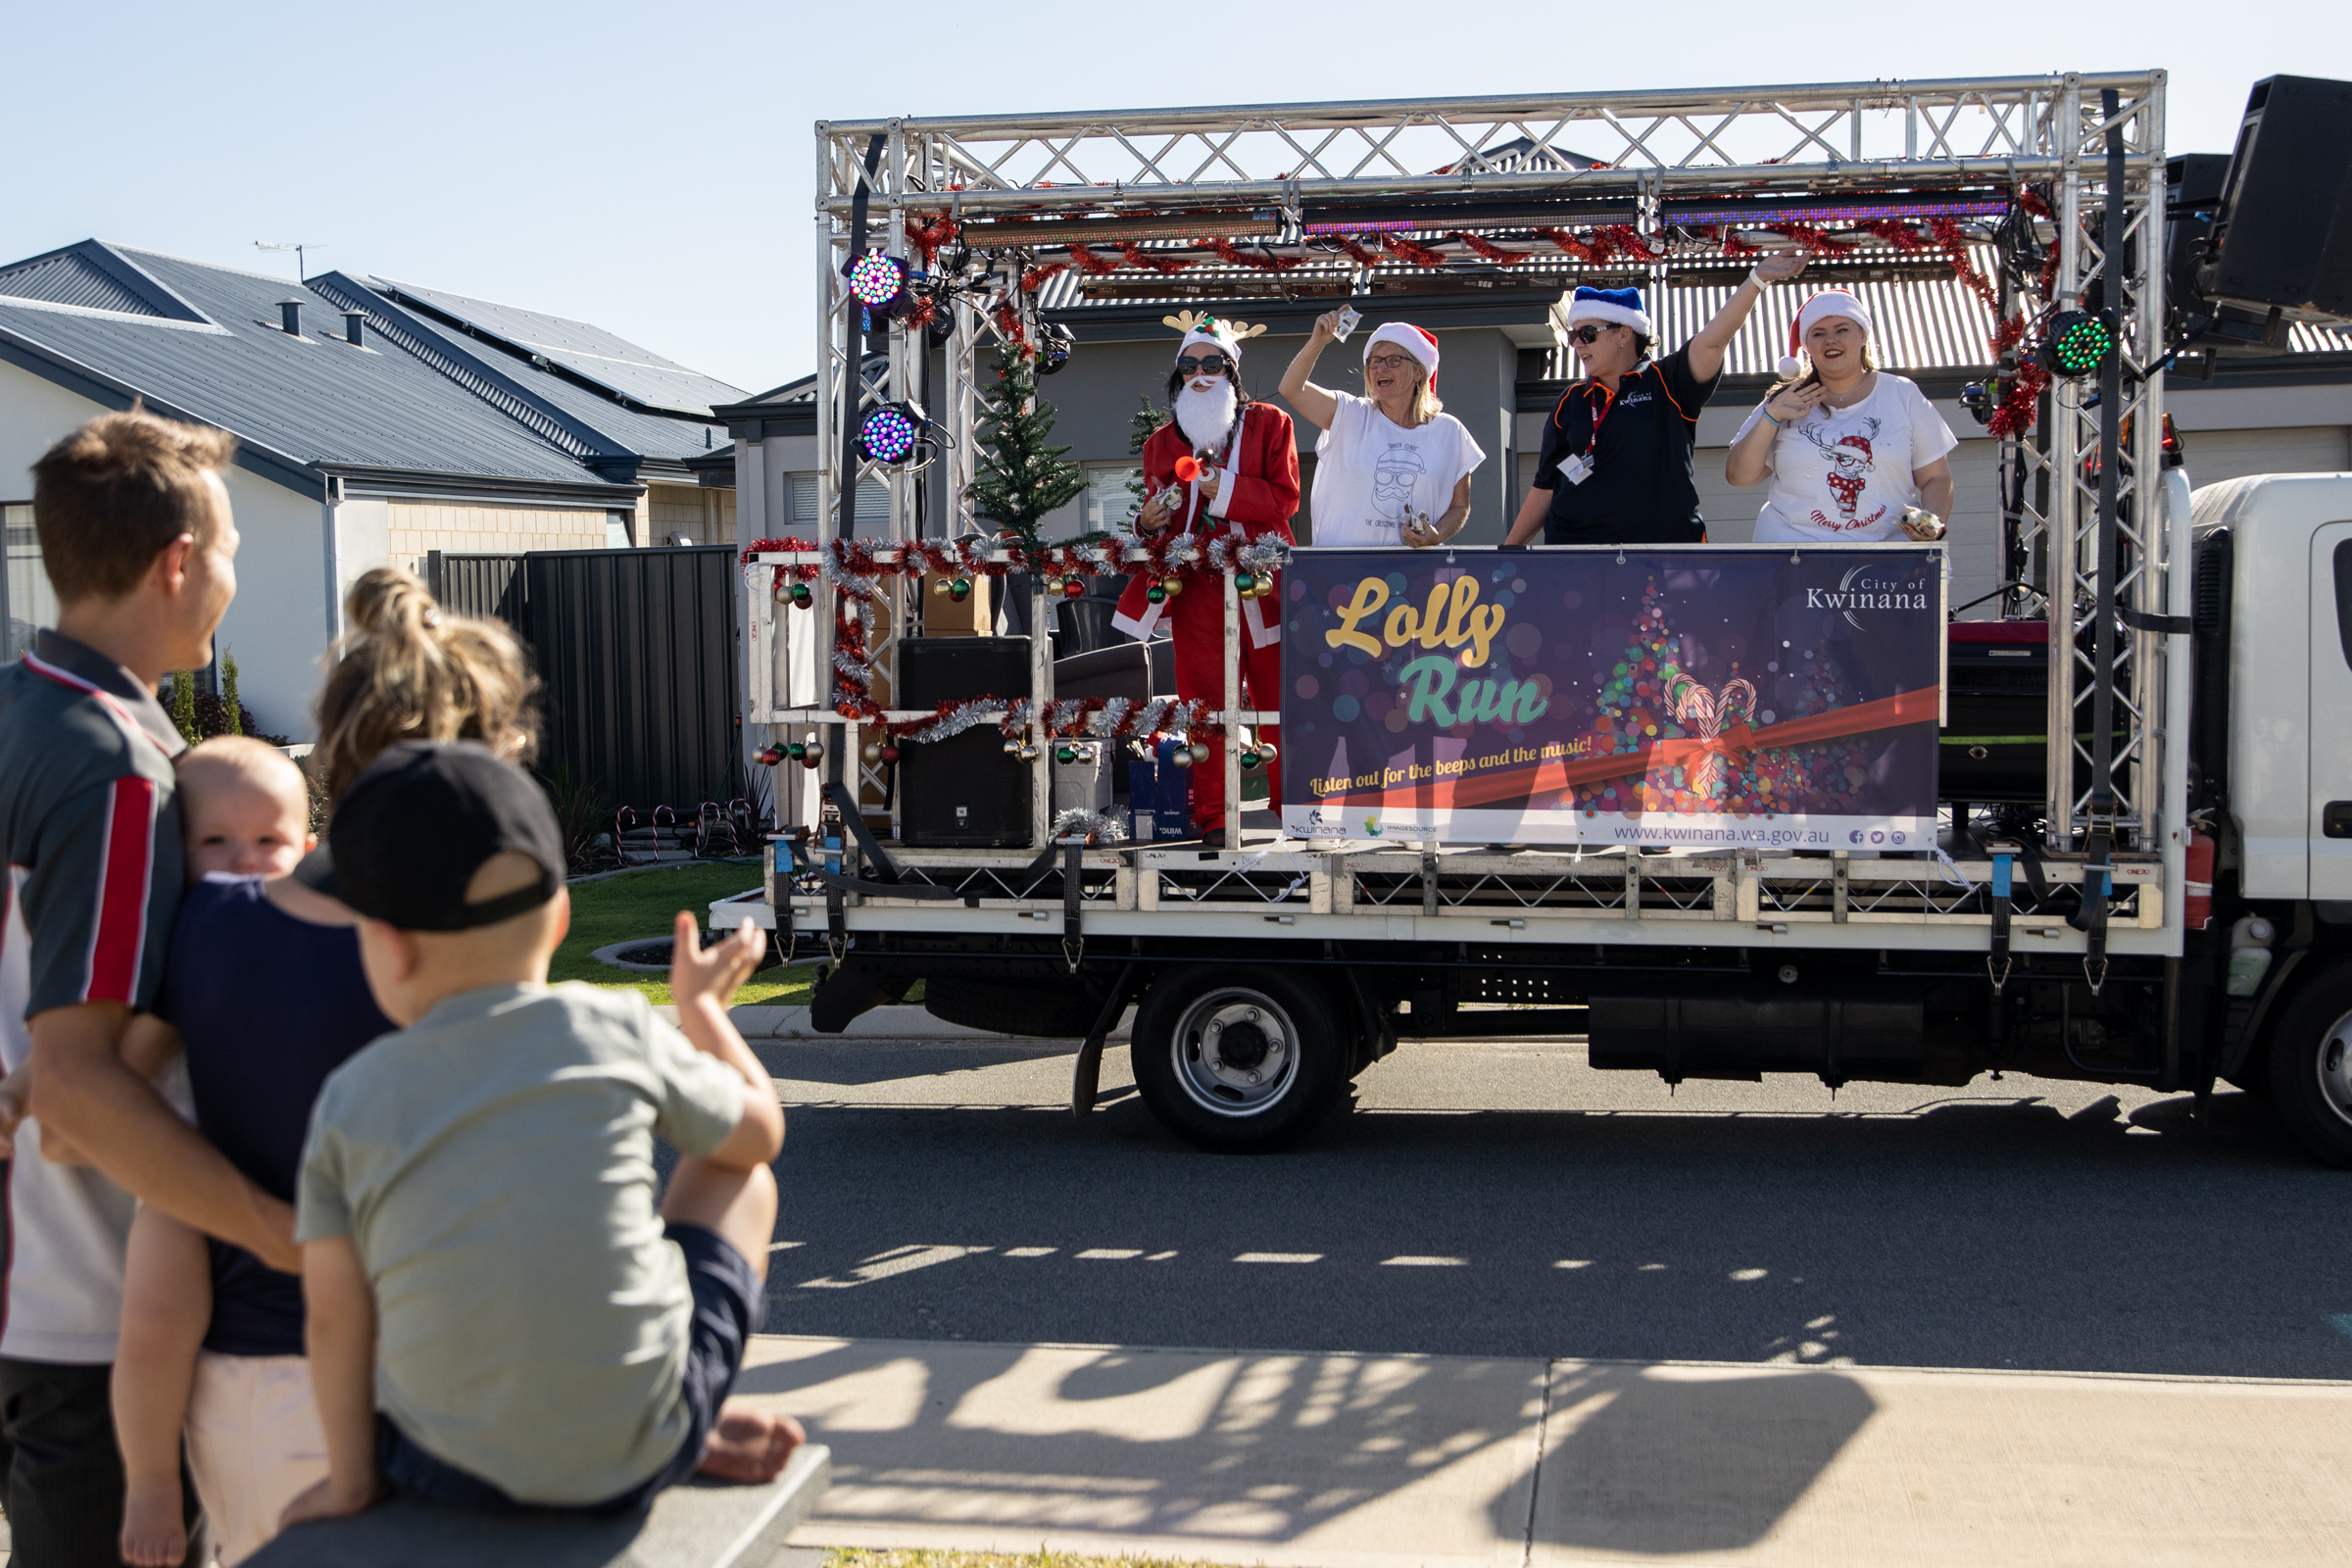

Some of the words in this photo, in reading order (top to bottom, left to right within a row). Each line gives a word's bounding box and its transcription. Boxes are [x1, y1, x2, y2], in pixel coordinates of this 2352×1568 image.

[1619, 395, 1652, 406] Kwinana
[1810, 510, 1842, 531] Merry
[1845, 504, 1887, 530] Christmas
[1861, 578, 1897, 592] City
[1908, 578, 1926, 589] of
[1806, 587, 1928, 609] Kwinana
[1325, 575, 1506, 668] Lolly
[1398, 655, 1548, 728] Run
[1310, 777, 1352, 798] Listen
[1355, 771, 1379, 787] out
[1381, 766, 1405, 789] for
[1409, 763, 1432, 780] the
[1436, 758, 1476, 776] beeps
[1479, 749, 1510, 768] and
[1513, 747, 1537, 763] the
[1541, 735, 1592, 760] music!
[1159, 827, 1183, 837] winc.
[1614, 826, 1830, 846] www.kwinana.wa.gov.au
